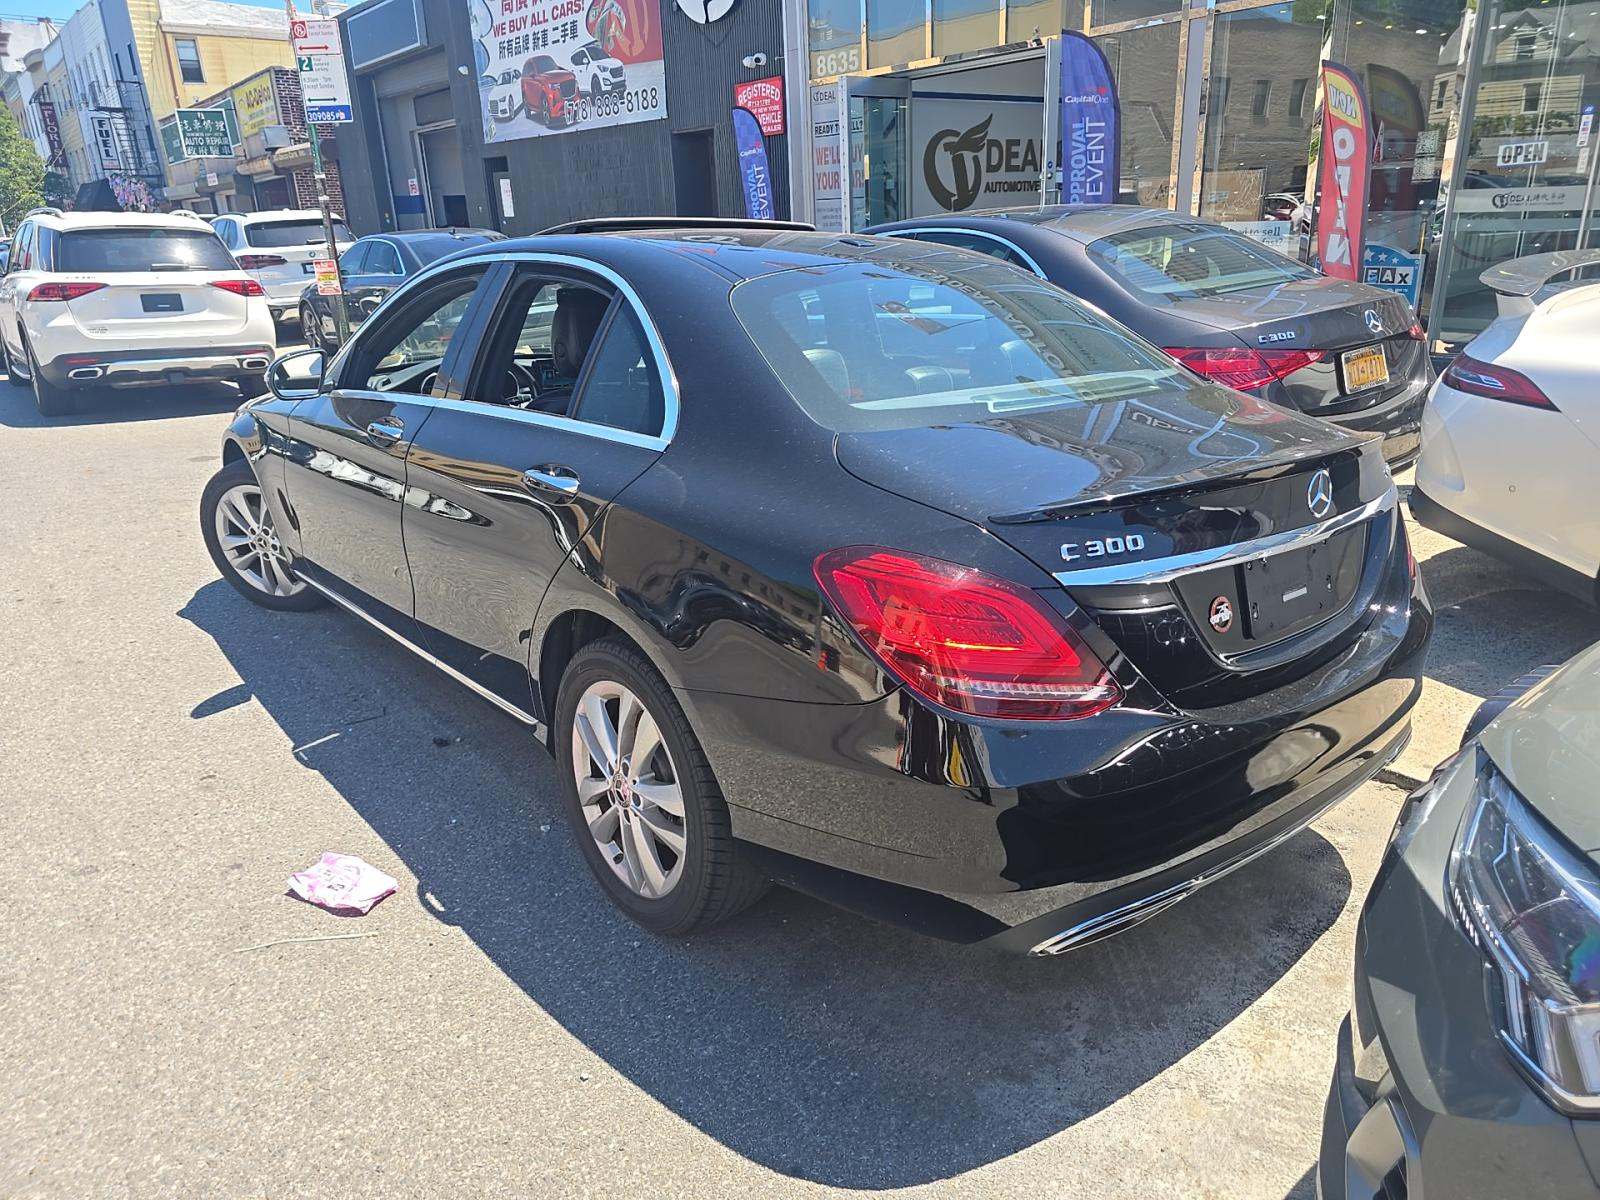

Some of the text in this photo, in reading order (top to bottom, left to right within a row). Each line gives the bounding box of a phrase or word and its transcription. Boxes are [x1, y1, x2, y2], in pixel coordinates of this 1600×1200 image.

[493, 0, 585, 38] WE BUY ALL CARS!
[551, 20, 579, 44] 二手車
[302, 56, 310, 71] 2
[817, 49, 858, 76] 8635
[564, 87, 659, 125] (718) 888-8188
[738, 82, 781, 107] REGISTERED
[307, 111, 336, 121] 309085
[97, 119, 114, 158] FUEL
[763, 124, 782, 133] EALER
[814, 123, 833, 136] READY
[185, 136, 230, 147] AUTO REPAIR
[1501, 142, 1546, 164] OPEN
[986, 138, 1042, 173] DEA
[1070, 116, 1086, 205] PPROVAL
[1085, 116, 1106, 196] EVENT
[744, 163, 761, 219] PROVAL
[816, 170, 840, 190] YOUR
[983, 180, 1042, 193] AUTOMOTIVE
[754, 165, 770, 220] EVENT
[1262, 226, 1281, 237] sell
[1258, 331, 1296, 343] C 300
[1060, 534, 1145, 561] C 300
